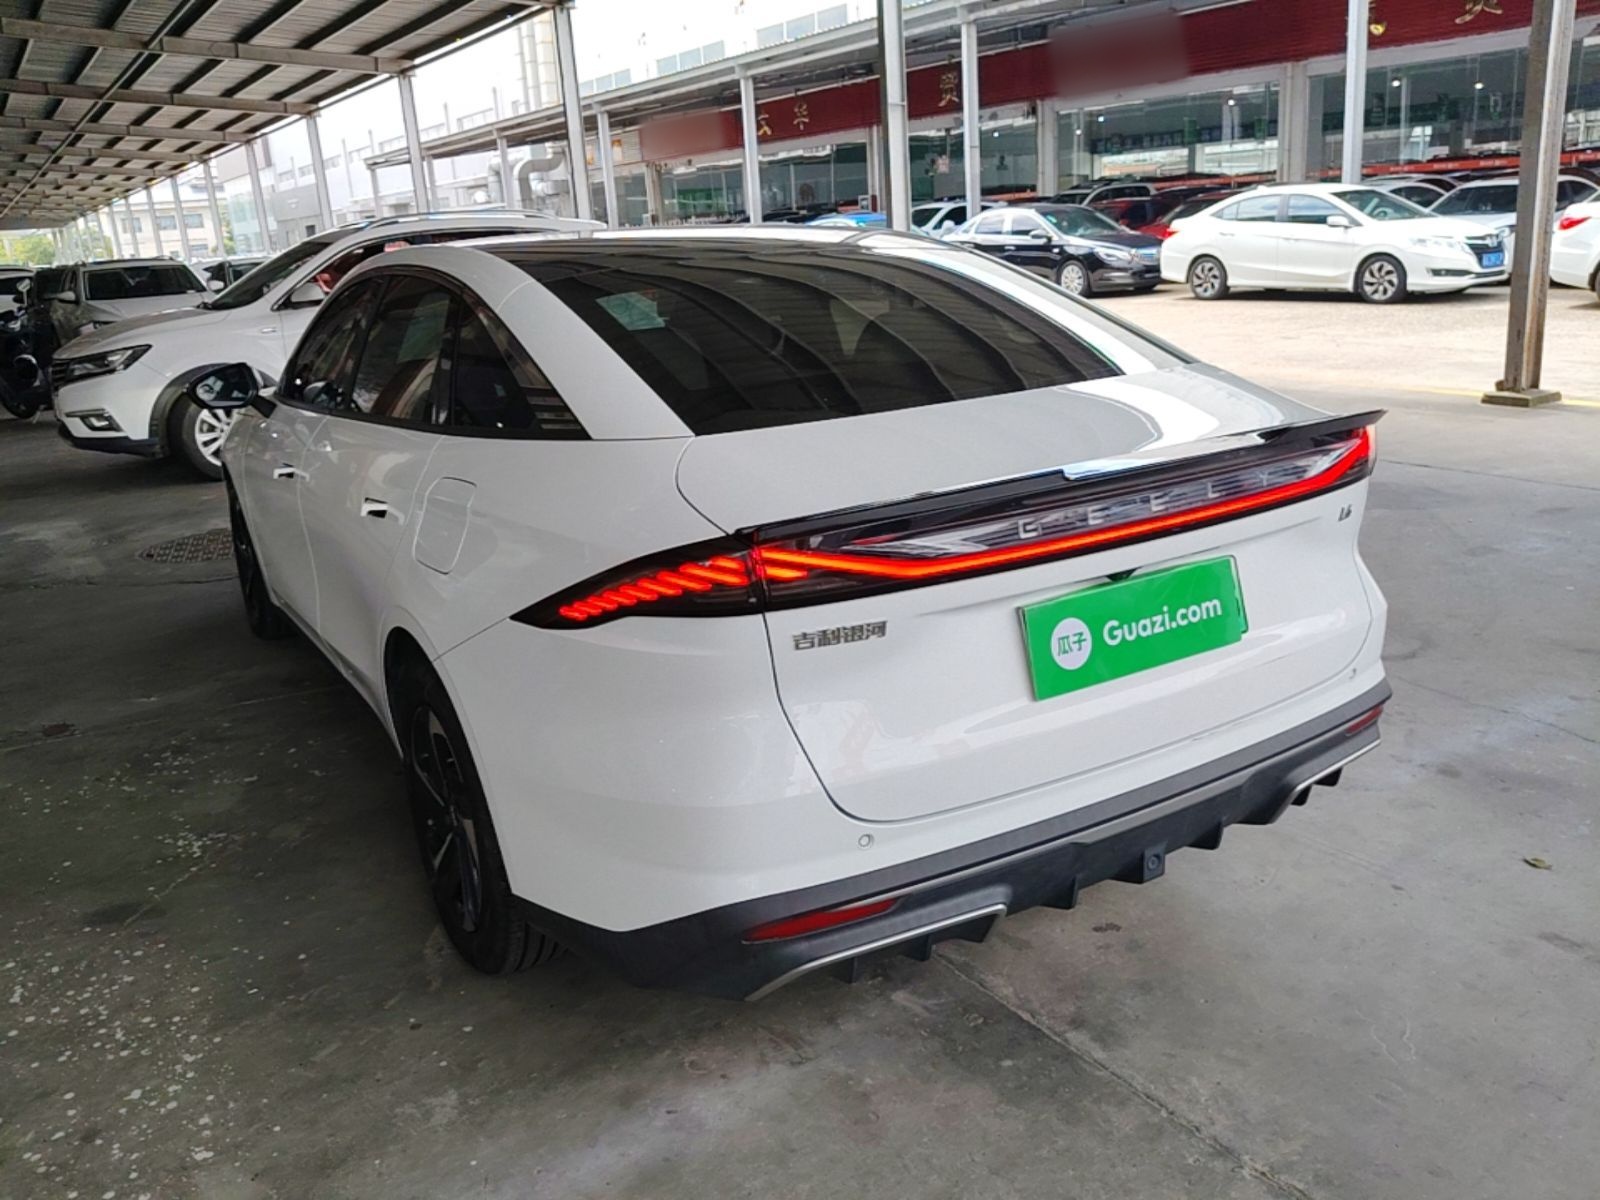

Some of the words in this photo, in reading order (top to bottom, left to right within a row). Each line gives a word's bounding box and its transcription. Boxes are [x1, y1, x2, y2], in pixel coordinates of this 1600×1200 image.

[1017, 471, 1270, 540] GEELY
[792, 619, 888, 651] 吉利银河
[1056, 631, 1088, 657] 瓜子
[1102, 598, 1223, 647] Guazi.com
